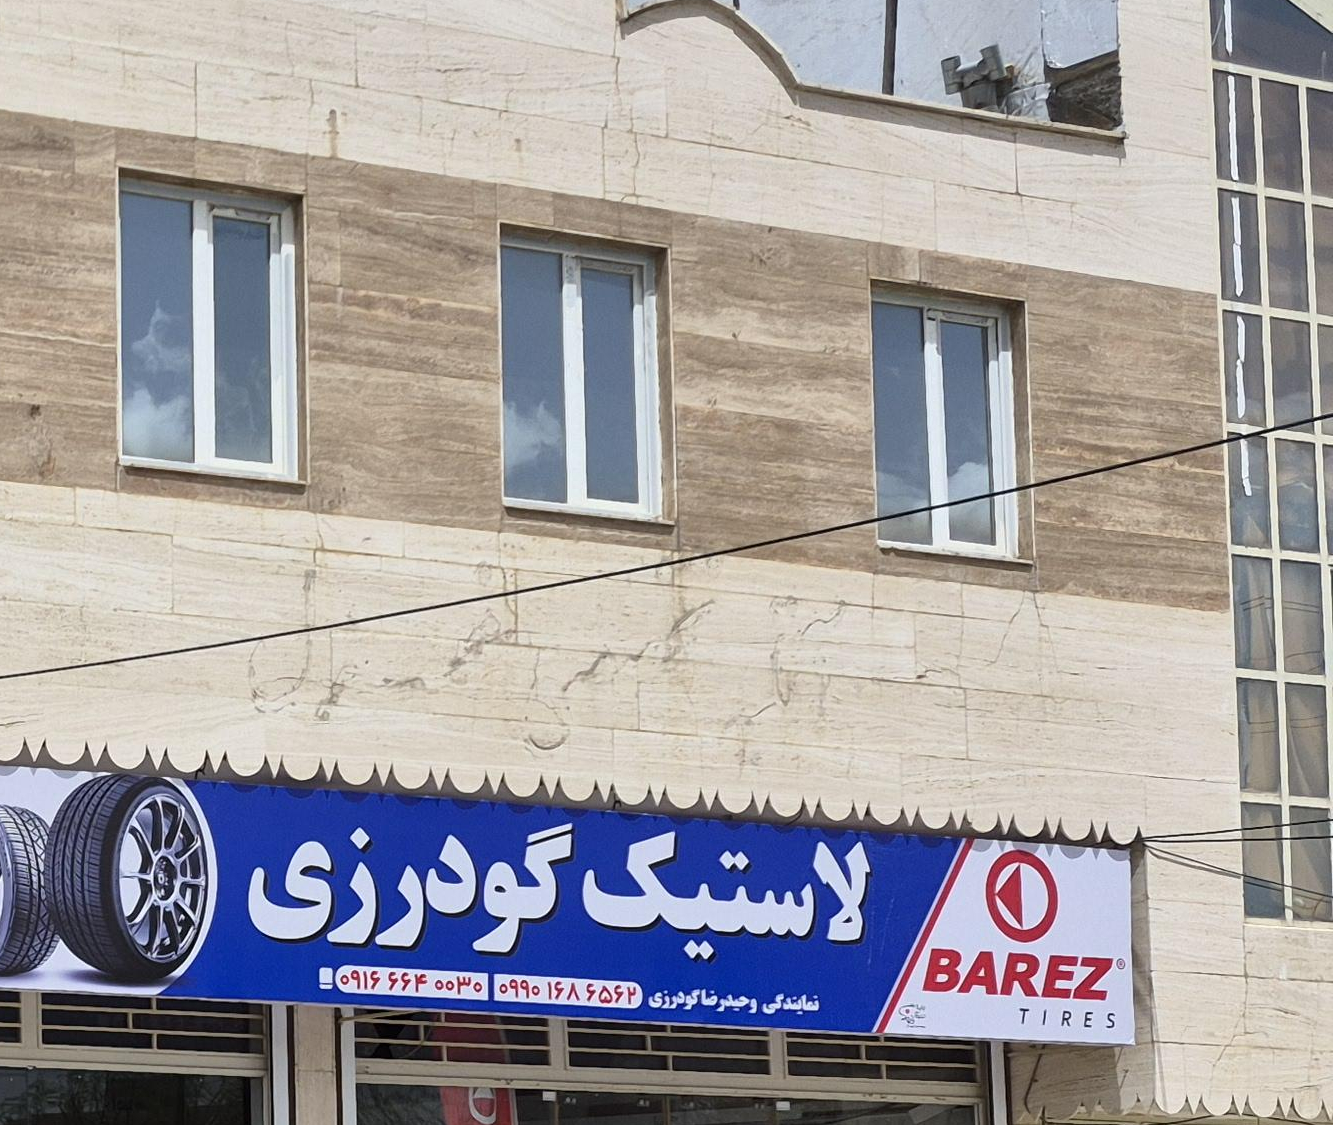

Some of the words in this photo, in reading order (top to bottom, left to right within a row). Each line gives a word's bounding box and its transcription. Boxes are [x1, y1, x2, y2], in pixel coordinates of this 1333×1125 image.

[247, 823, 574, 953] گودرزی
[582, 831, 872, 960] لاستیک
[922, 947, 1115, 1002] BAREZ
[1019, 1007, 1117, 1029] TIRES
